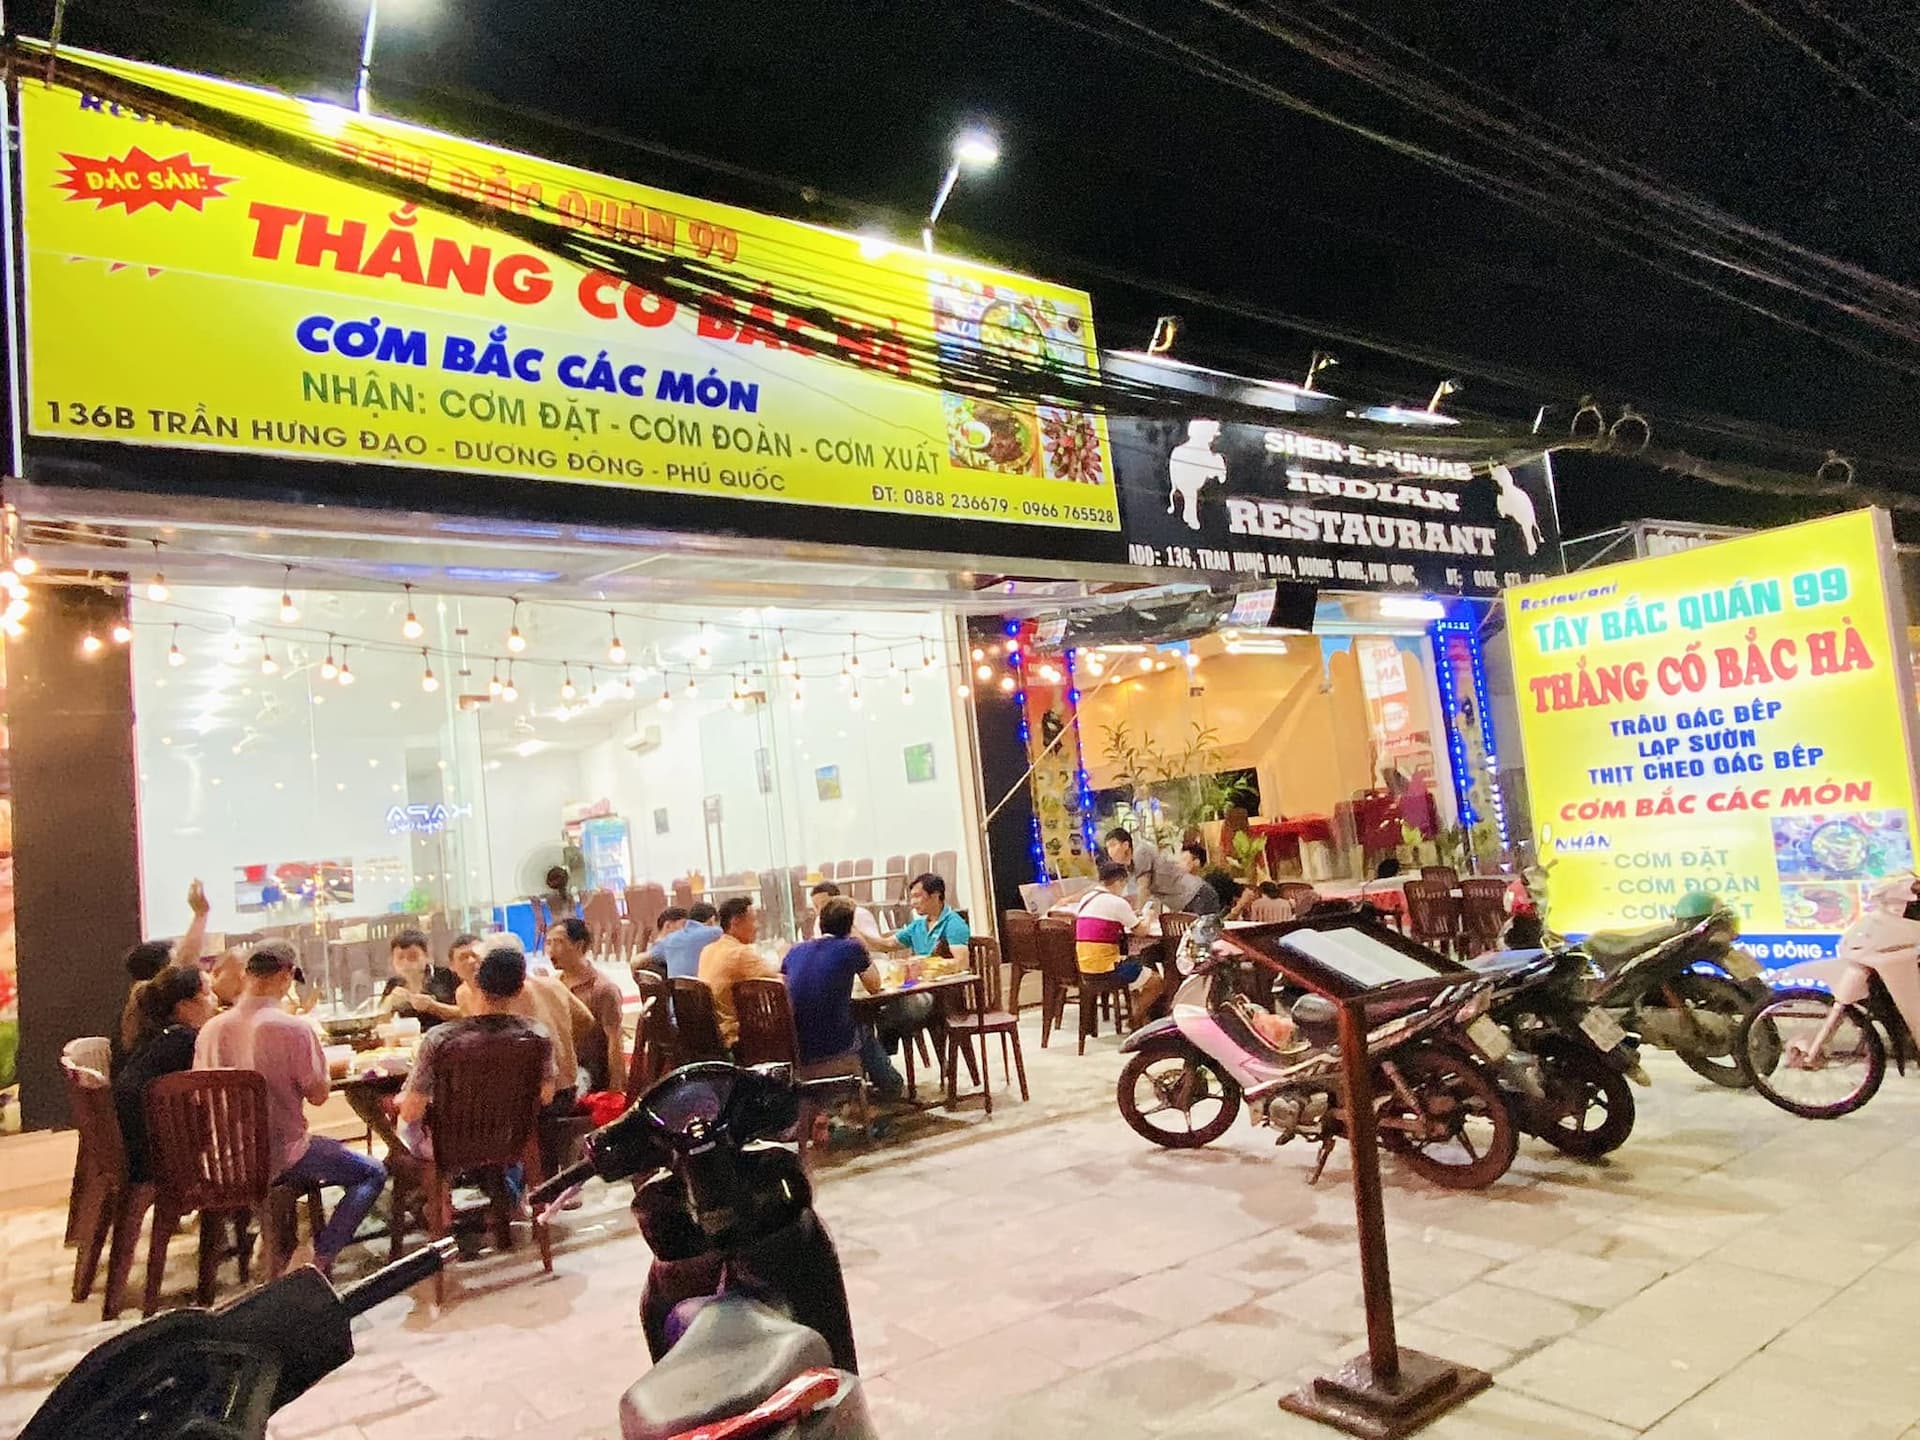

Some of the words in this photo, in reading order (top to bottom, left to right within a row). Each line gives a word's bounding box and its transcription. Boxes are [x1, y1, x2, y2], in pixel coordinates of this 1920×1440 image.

[85, 167, 142, 193] ĐẶC
[248, 200, 554, 305] THẮNG
[689, 219, 738, 264] 99
[296, 315, 428, 367] CƠM
[442, 324, 545, 382] BẮC
[557, 350, 647, 396] CÁC
[656, 367, 759, 413] MÓN
[302, 369, 427, 419] NHẬN:
[439, 388, 527, 428] CƠM
[538, 396, 601, 441] ĐẶT
[629, 413, 702, 448] CƠM
[711, 420, 792, 459] ĐOÀN
[814, 436, 875, 469] CƠM
[883, 440, 940, 476] XUẤT
[46, 400, 136, 430] 136B
[147, 401, 239, 438] TRẦN
[252, 418, 348, 448] HƯNG
[359, 429, 428, 460] ĐẠO
[454, 439, 558, 469] DƯƠNG
[567, 450, 644, 478] ĐÔNG
[666, 461, 711, 485] PHÚ
[719, 465, 786, 492] QUỐC
[872, 485, 898, 503] ĐT:
[903, 488, 945, 507] 0888
[951, 493, 1008, 513] 236679
[1022, 500, 1058, 518] 0966
[1063, 505, 1114, 524] 765528
[1286, 469, 1461, 512] INDIAN
[1226, 499, 1497, 556] RESTAURANT
[1520, 582, 1619, 611] Restaurant
[1534, 616, 1590, 652] TÂY
[1601, 595, 1668, 641] BẮC
[1678, 580, 1782, 630] QUÁN
[1793, 567, 1848, 607] 99
[1806, 616, 1874, 676] HÀ
[1609, 714, 1668, 737] TRÂU
[1675, 707, 1725, 730] GÁC
[1588, 765, 1634, 787] THỊT
[1643, 758, 1705, 781] CHEO
[1713, 752, 1764, 775] GÁC
[1638, 737, 1681, 760] LẠP
[1560, 798, 1627, 822] CƠM
[1635, 785, 1697, 817] BẮC
[1706, 785, 1772, 812] CÁC
[1780, 777, 1873, 808] MÓN
[1613, 847, 1672, 869] CƠM
[1680, 845, 1729, 872] ĐẶT
[1617, 875, 1676, 895] CƠM
[1772, 940, 1823, 959] ĐÔNG
